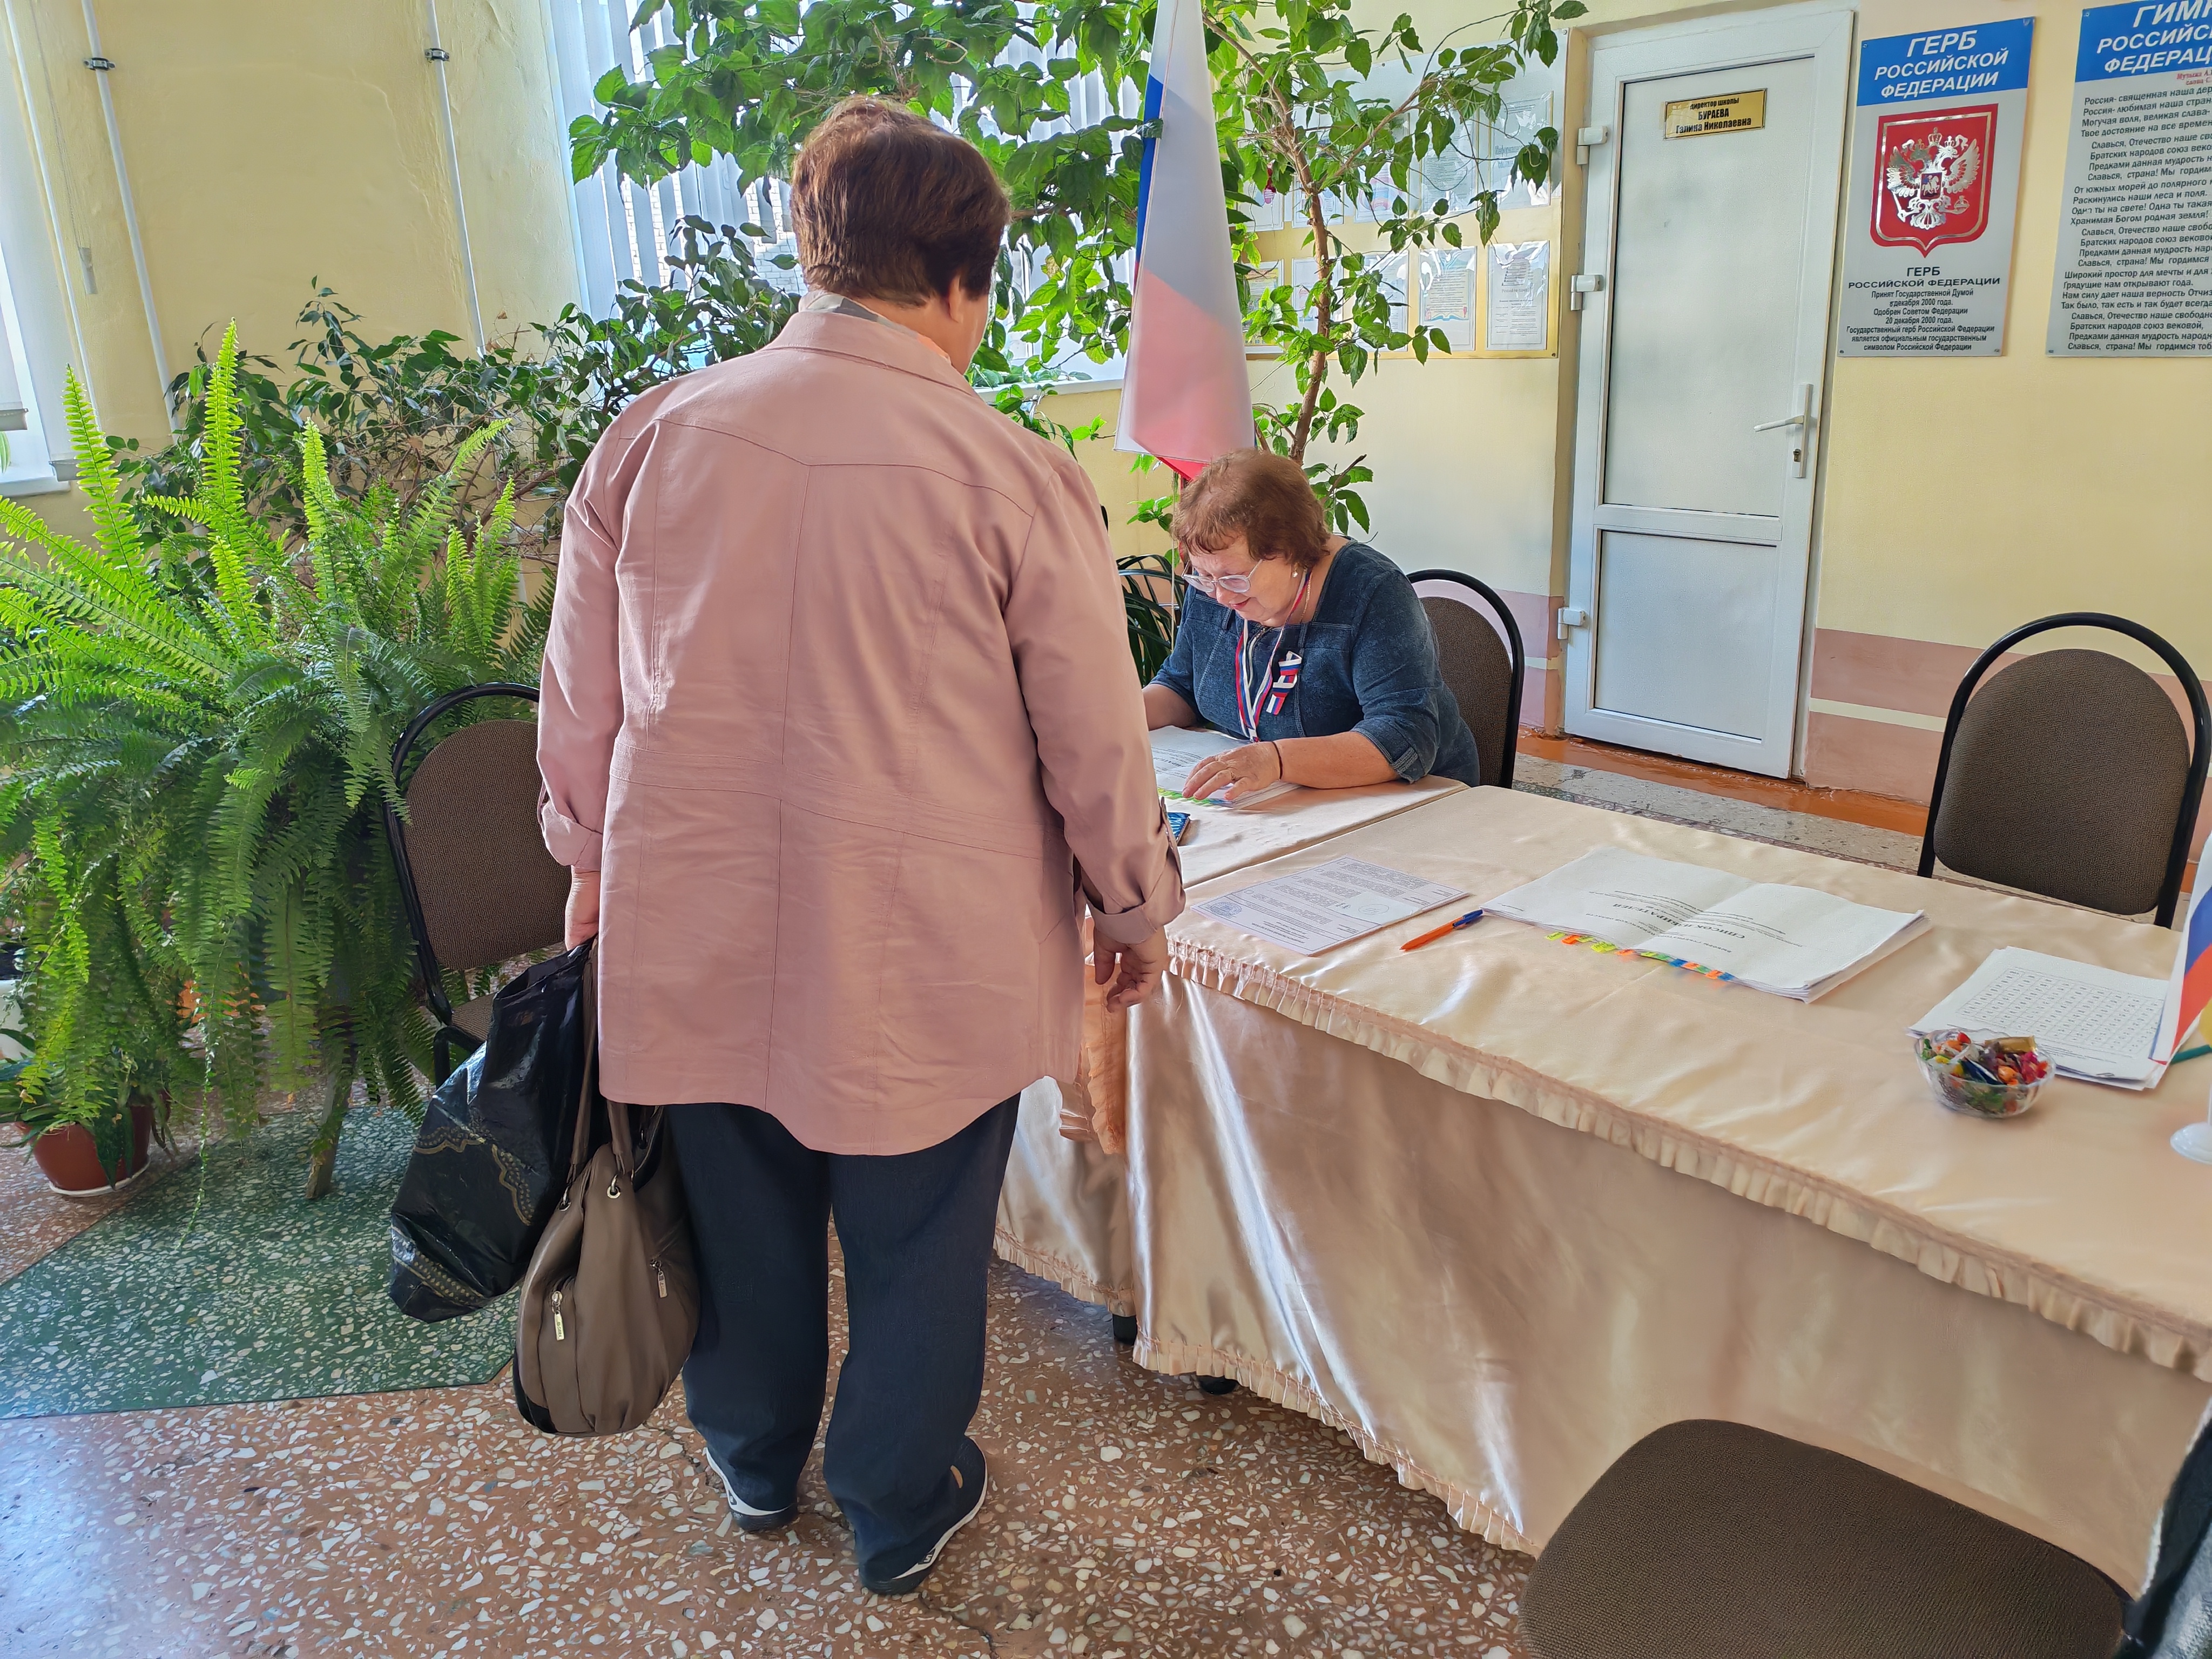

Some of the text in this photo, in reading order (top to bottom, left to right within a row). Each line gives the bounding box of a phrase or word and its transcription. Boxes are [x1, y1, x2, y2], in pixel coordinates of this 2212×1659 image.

[1907, 30, 1978, 57] ГЕРБ
[2096, 23, 2212, 54] РОССИЙС
[1874, 47, 2009, 80] РОССИЙСКОЙ
[2104, 46, 2212, 73] ФЕДЕРАЦ
[1881, 71, 1999, 99] ФЕДЕРАЦИИ
[2118, 91, 2167, 102] священная
[2169, 87, 2195, 97] наша
[1690, 97, 1739, 111] директор школы
[2116, 102, 2157, 113] любимая
[2160, 100, 2183, 109] наша
[2186, 95, 2212, 107] стран
[1698, 107, 1729, 120] БУРАЕВА
[2082, 118, 2117, 127] Могучая
[2119, 116, 2141, 124] воля,
[2143, 111, 2180, 122] великая
[1676, 117, 1751, 133] Галина Николаевна
[2081, 129, 2100, 137] Твое
[2101, 126, 2146, 137] достояние
[2161, 123, 2176, 131] все
[2128, 137, 2171, 147] Отечество
[2174, 134, 2198, 143] наше
[2090, 141, 2212, 161] Братских народов союз веко
[2089, 161, 2130, 172] Предками
[2131, 159, 2162, 169] данная
[2164, 156, 2205, 166] мудрость
[2127, 168, 2159, 180] страна!
[2160, 167, 2175, 177] Мы
[2180, 164, 2212, 176] гордим
[2074, 186, 2084, 194] От
[2086, 185, 2116, 193] южных
[2117, 181, 2146, 193] морей
[2147, 181, 2159, 191] до
[2160, 179, 2207, 189] полярного
[2073, 195, 2126, 205] Раскинулись
[2128, 193, 2152, 201] наши
[2153, 192, 2174, 200] леса
[2120, 203, 2147, 212] свете!
[2149, 202, 2171, 212] Одна
[2070, 217, 2113, 227] Хранимая
[2116, 214, 2142, 223] Богом
[2144, 213, 2176, 223] родная
[2118, 226, 2160, 235] Отечество
[2080, 238, 2117, 248] Братских
[2119, 237, 2154, 246] народов
[2079, 242, 2212, 258] Предками данная мудрость нар
[2116, 257, 2148, 267] страна!
[2149, 256, 2164, 265] Мы
[2168, 255, 2210, 266] гордимся
[1906, 266, 1940, 277] ГЕРБ
[2064, 269, 2103, 281] Широкий
[2104, 271, 2138, 280] простор
[2139, 269, 2154, 278] для
[2193, 268, 2209, 276] для
[1848, 277, 2000, 289] РОССИЙСКОЙ ФЕДЕРАЦИИ
[2063, 281, 2102, 291] Грядущие
[2123, 280, 2171, 289] открывают
[1871, 287, 1974, 300] Принят Государственной Думой
[2062, 291, 2080, 299] Нам
[2081, 291, 2100, 301] силу
[2100, 290, 2120, 300] дает
[2146, 290, 2186, 299] верность
[1893, 298, 1953, 308] декабря 2000 года.
[2061, 301, 2075, 309] Так
[2101, 300, 2115, 308] так
[2160, 299, 2183, 309] будет
[1873, 306, 1968, 317] Одобрен Советом Федерации
[2107, 311, 2148, 321] Отечество
[2149, 312, 2173, 320] наше
[1885, 315, 1954, 326] 20 декабря 2000 года.
[2069, 322, 2106, 332] Братских
[2107, 323, 2141, 331] народов
[2143, 321, 2164, 330] союз
[1846, 324, 1995, 335] Государственный герб Российской Федерации
[1881, 334, 1927, 343] официальным
[1928, 333, 1987, 343] государственным
[2068, 332, 2109, 342] Предками
[2109, 332, 2140, 341] данная
[2141, 333, 2180, 341] мудрость
[1896, 342, 1934, 351] Российской
[1935, 342, 1972, 352] Федерации
[2106, 342, 2136, 352] страна!
[2137, 342, 2152, 350] Мы
[2156, 341, 2196, 352] гордимся
[2198, 340, 2212, 352] тоб
[1696, 925, 1745, 939] СПИСОК
